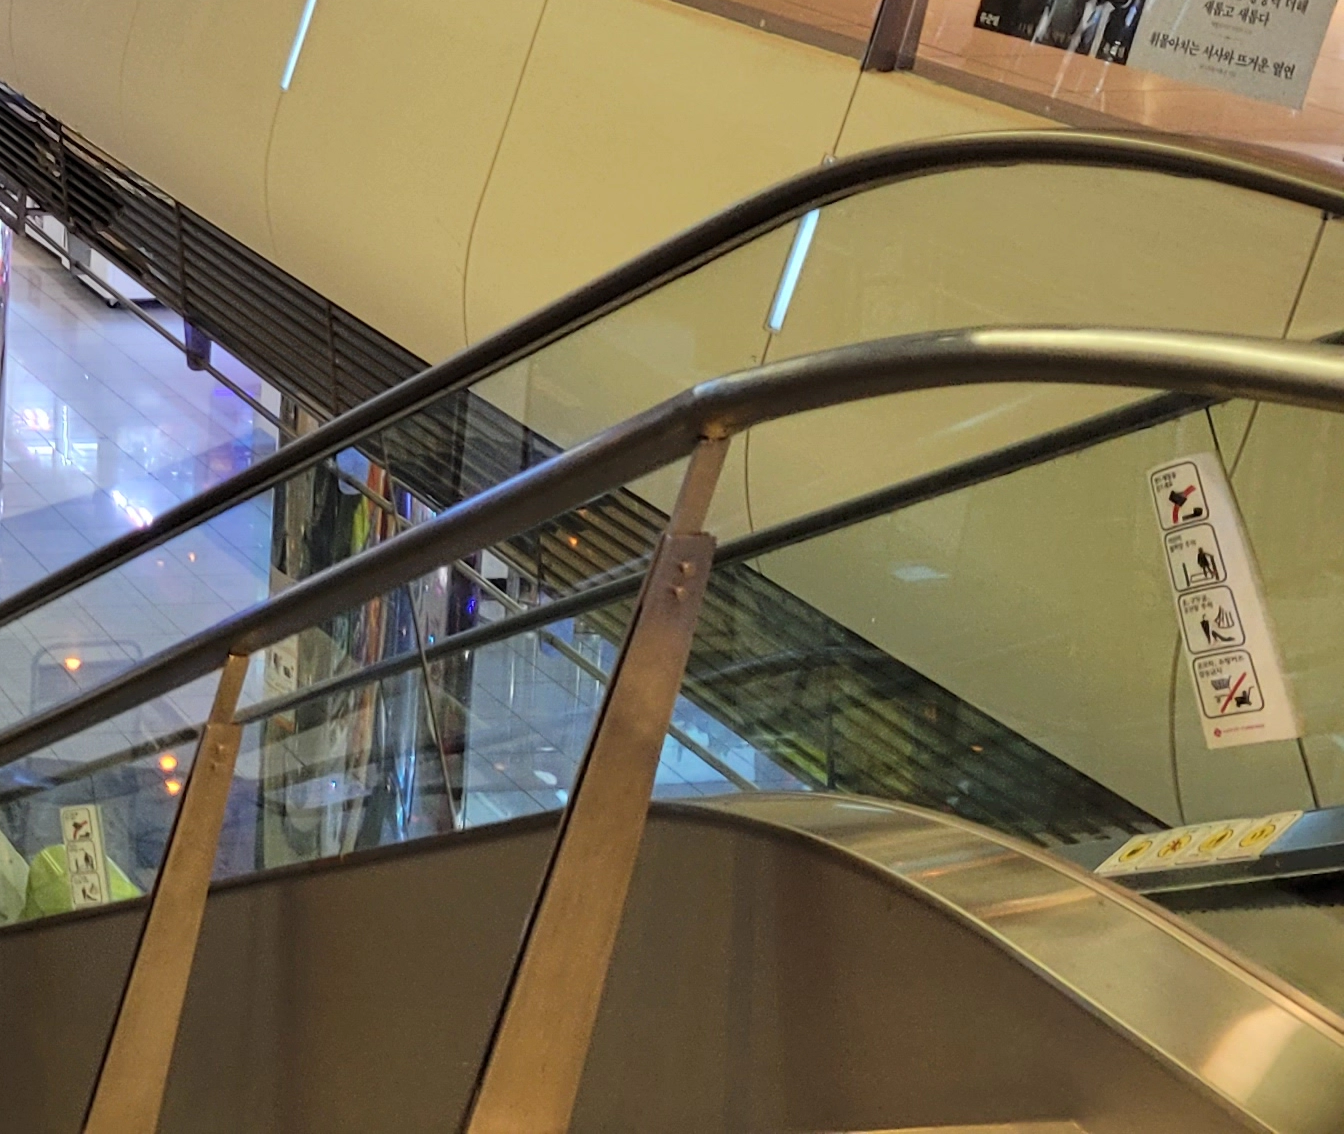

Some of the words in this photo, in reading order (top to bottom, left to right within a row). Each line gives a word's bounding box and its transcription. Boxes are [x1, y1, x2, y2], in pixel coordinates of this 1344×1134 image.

[1204, 0, 1235, 19] 새롭고
[1238, 5, 1271, 27] 새롭다
[1150, 31, 1201, 57] 휘몰아치는
[1202, 43, 1235, 65] 서사와
[1235, 53, 1270, 73] 뜨거운
[1272, 61, 1297, 81] 열연
